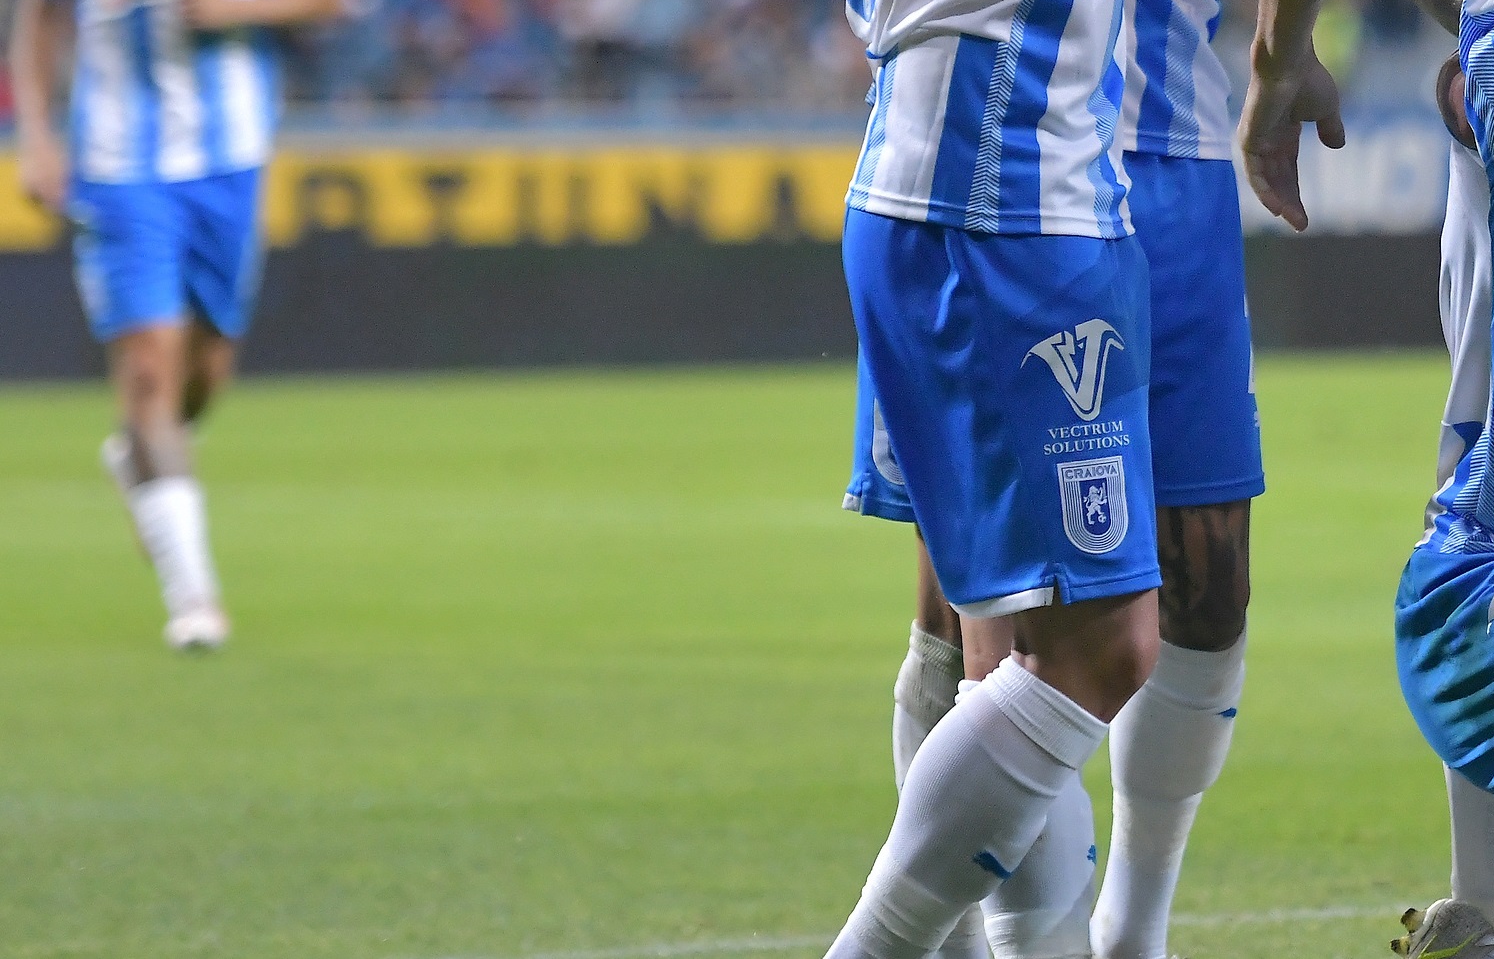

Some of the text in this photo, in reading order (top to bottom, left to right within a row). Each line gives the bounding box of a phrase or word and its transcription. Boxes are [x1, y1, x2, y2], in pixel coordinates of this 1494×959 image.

[1047, 420, 1124, 439] VECTRUM
[1043, 434, 1130, 456] SOLUTIONS
[1064, 464, 1118, 480] CRAIOVA
